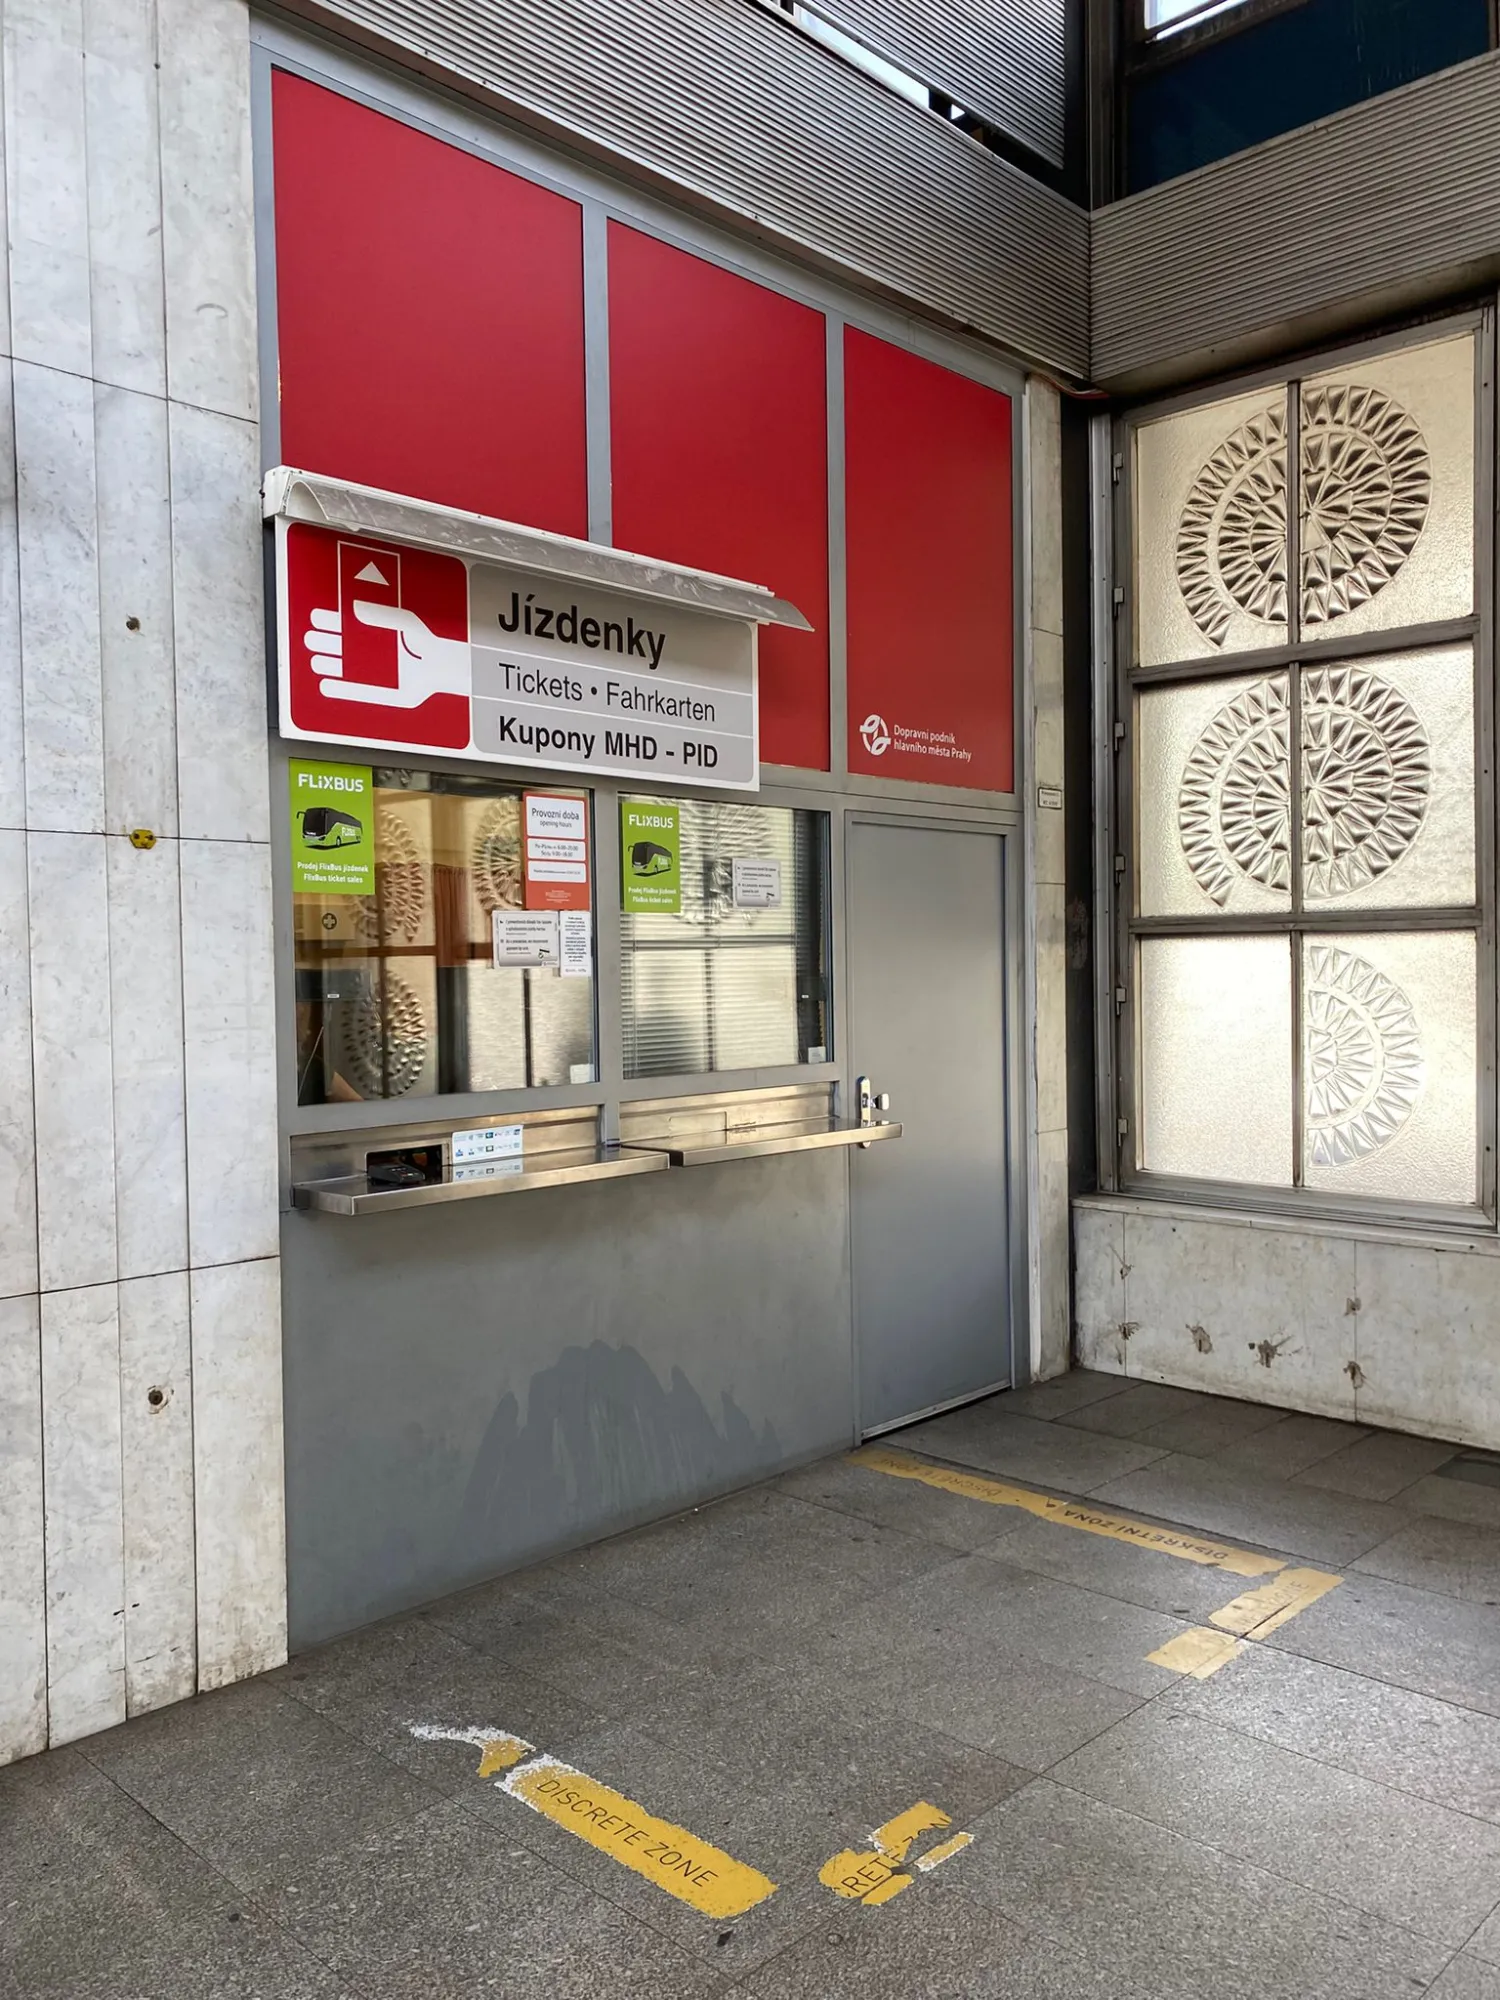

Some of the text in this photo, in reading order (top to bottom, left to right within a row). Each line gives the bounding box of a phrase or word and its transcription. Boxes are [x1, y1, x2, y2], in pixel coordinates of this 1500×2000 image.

[498, 591, 667, 670] Jízdenky
[498, 662, 716, 722] Tickets Fahrkarten
[499, 715, 596, 760] Kupony
[604, 730, 658, 761] MHD
[683, 741, 718, 768] PID
[893, 724, 956, 744] Dopravní podnik
[893, 739, 972, 763] hlavního města Prahy
[562, 810, 580, 820] doba
[536, 1779, 719, 1888] DISCRETE ZONE
